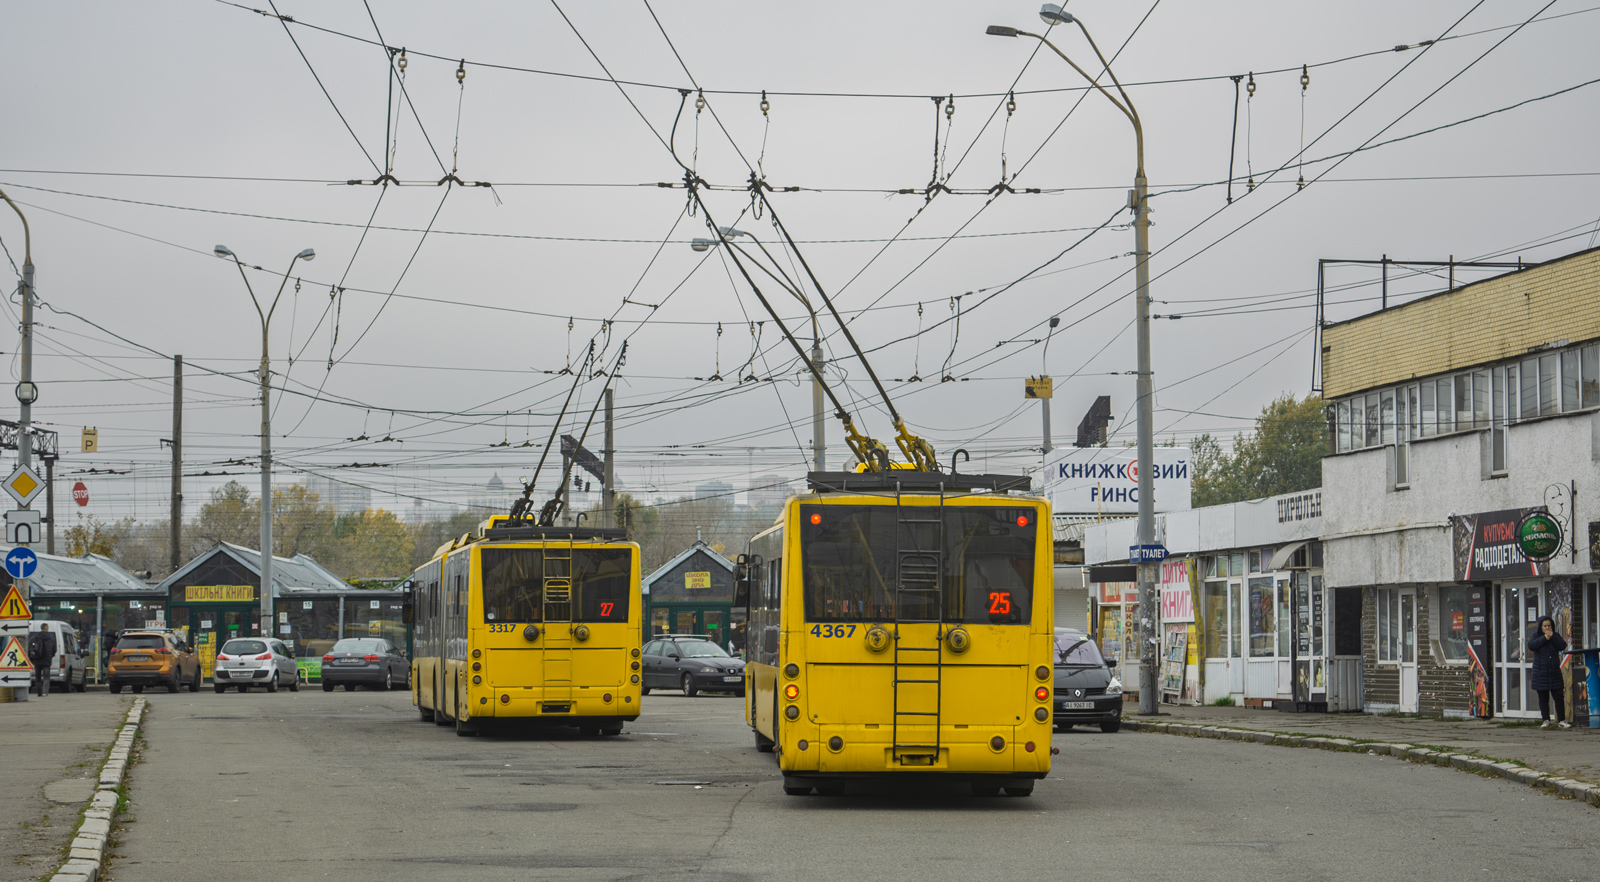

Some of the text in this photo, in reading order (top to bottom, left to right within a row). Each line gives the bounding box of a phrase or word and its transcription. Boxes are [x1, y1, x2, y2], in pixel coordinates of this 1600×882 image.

[73, 489, 88, 499] STOP
[1091, 487, 1156, 502] РИНО
[1484, 521, 1515, 543] КУПУЄМО
[1141, 548, 1166, 559] ТУАЛЕТ
[186, 587, 253, 600] ШКІЛЬНІ КНИГИ
[600, 602, 614, 616] 27
[989, 592, 1010, 613] 25
[488, 624, 516, 633] 3317
[810, 624, 857, 638] 4367
[1125, 606, 1133, 642] ШКОЛА
